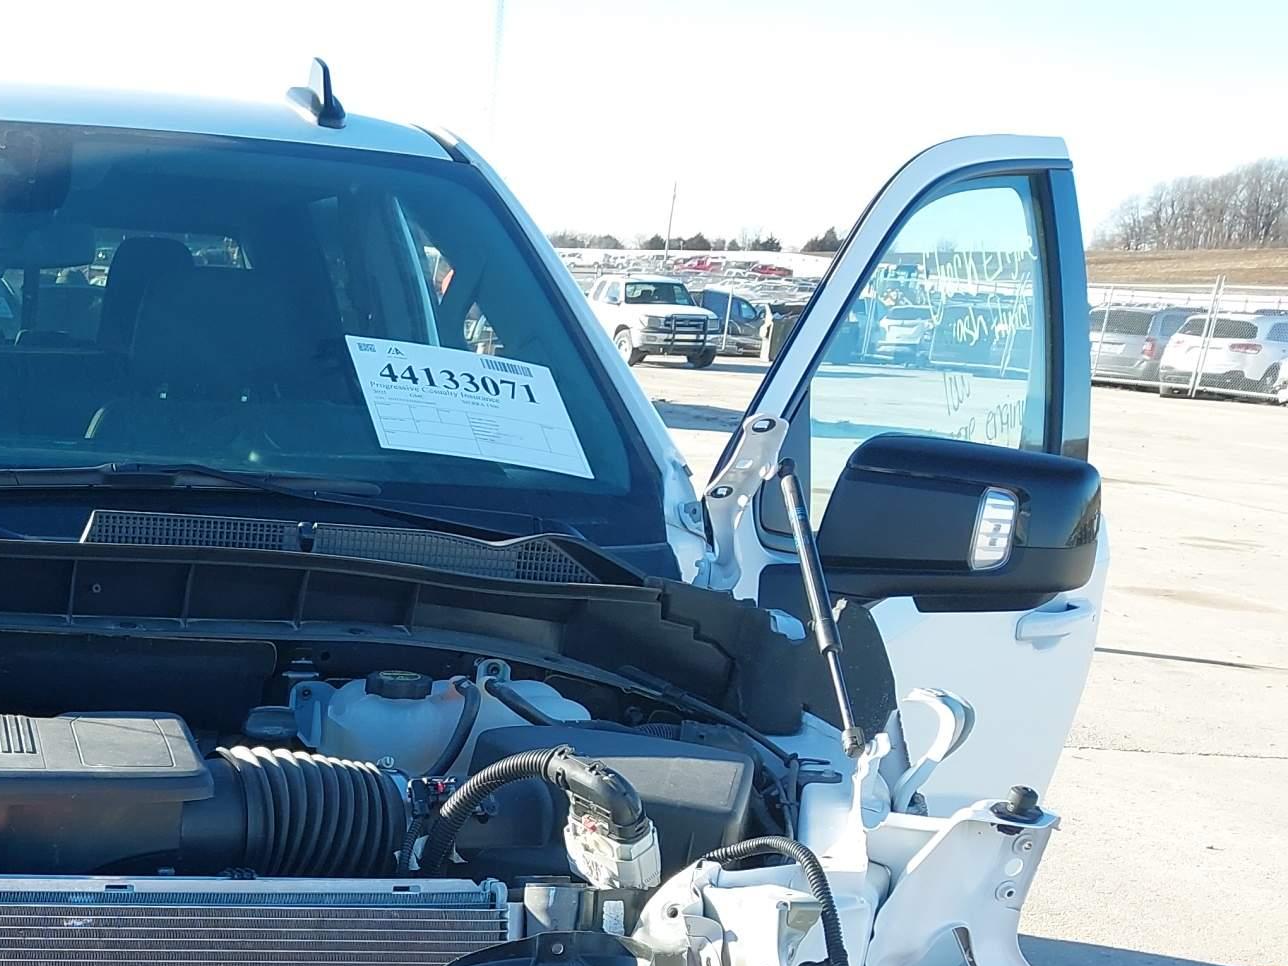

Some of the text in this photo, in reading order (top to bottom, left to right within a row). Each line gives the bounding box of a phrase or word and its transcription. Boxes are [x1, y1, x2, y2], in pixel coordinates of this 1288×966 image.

[369, 380, 500, 403] Progressive Casualty Insurance
[379, 363, 540, 405] 44133071
